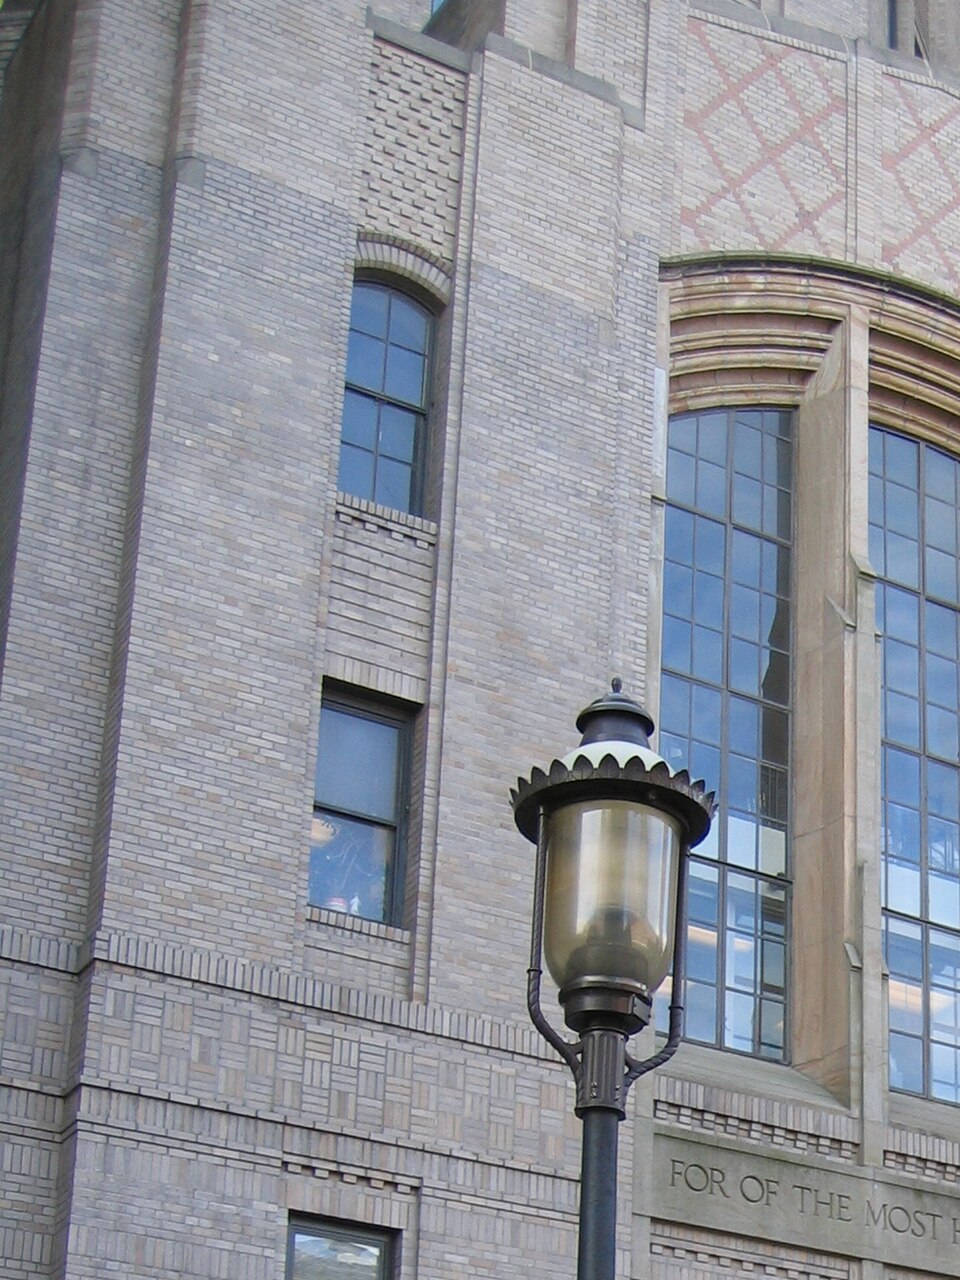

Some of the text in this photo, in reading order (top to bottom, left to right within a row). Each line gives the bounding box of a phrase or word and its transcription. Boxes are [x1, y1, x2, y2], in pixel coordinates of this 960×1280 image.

[670, 1158, 730, 1200] FOR
[739, 1173, 781, 1207] OF
[793, 1183, 853, 1223] THE
[864, 1199, 943, 1239] MOST
